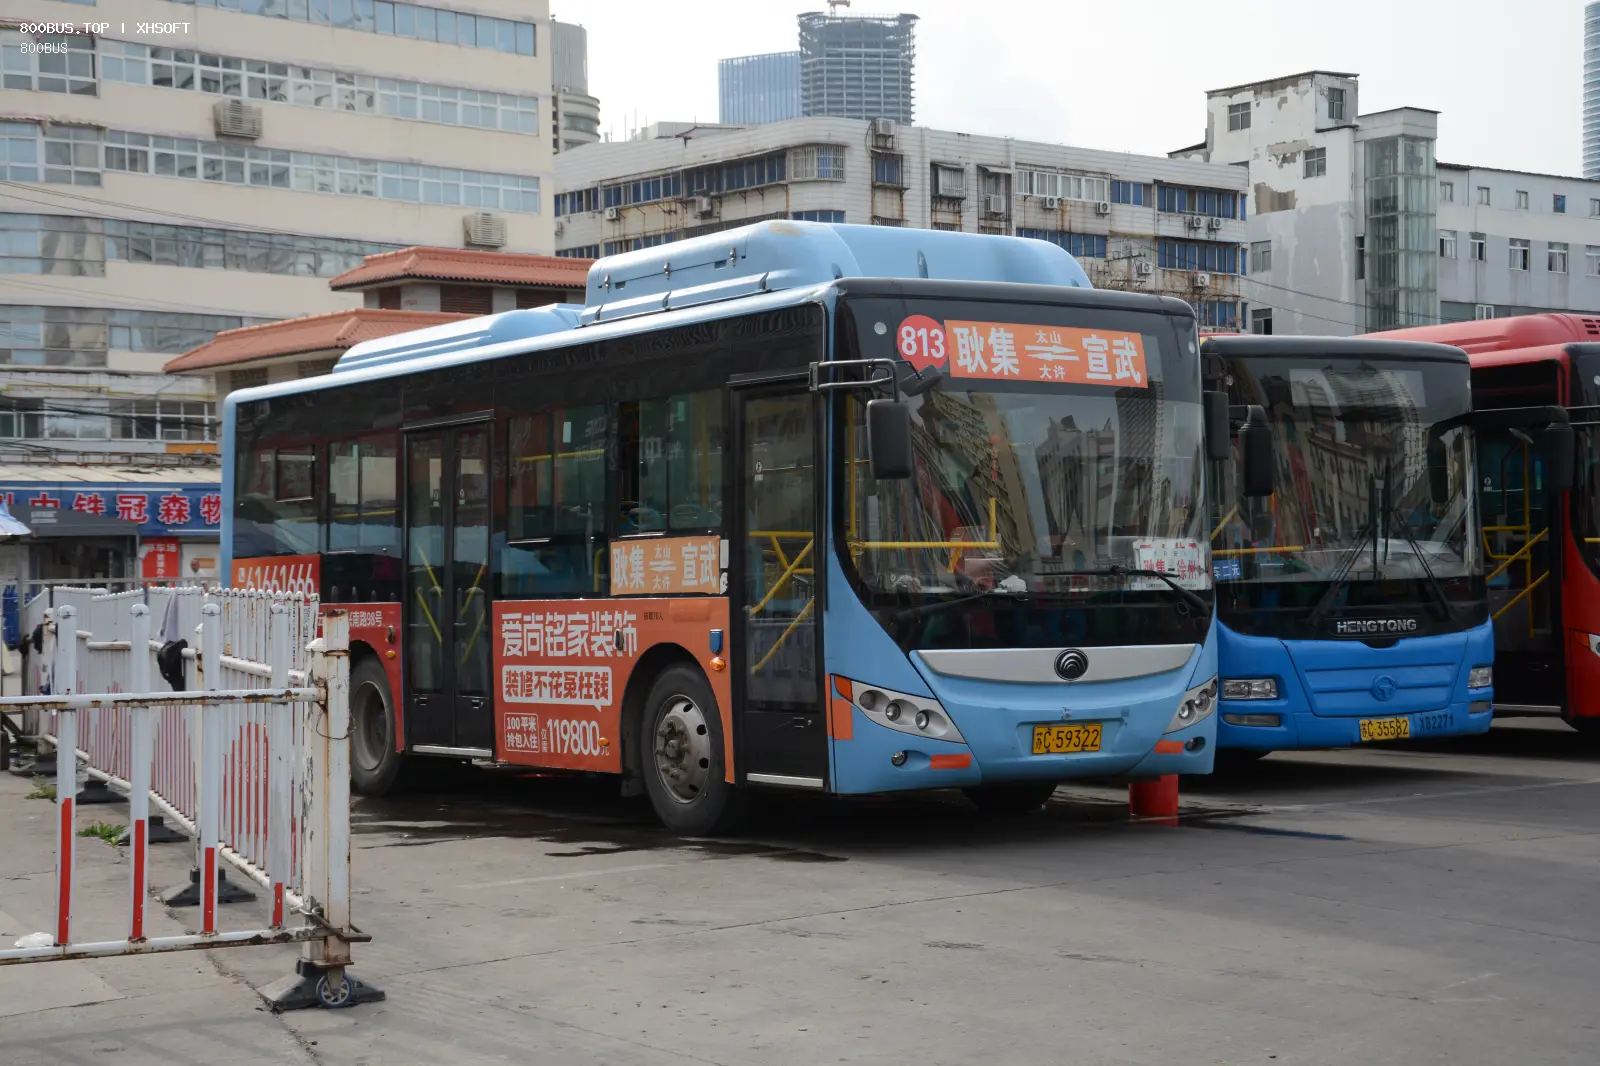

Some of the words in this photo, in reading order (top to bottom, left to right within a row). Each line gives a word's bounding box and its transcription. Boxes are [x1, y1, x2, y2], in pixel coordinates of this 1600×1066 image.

[901, 325, 945, 359] 813
[953, 326, 1020, 376] 耿集
[1081, 334, 1142, 384] 宣武
[1039, 364, 1066, 381] 大许
[0, 492, 221, 524] 中铁冠森物
[612, 545, 645, 589] 耿集
[681, 541, 717, 588] 宣武
[501, 610, 638, 657] 爱尚铭家装饰
[1336, 619, 1417, 633] HENGTONG
[505, 670, 609, 700] 装修不花冤枉钱
[506, 716, 537, 732] 100平米
[506, 733, 538, 749] 拎包入住
